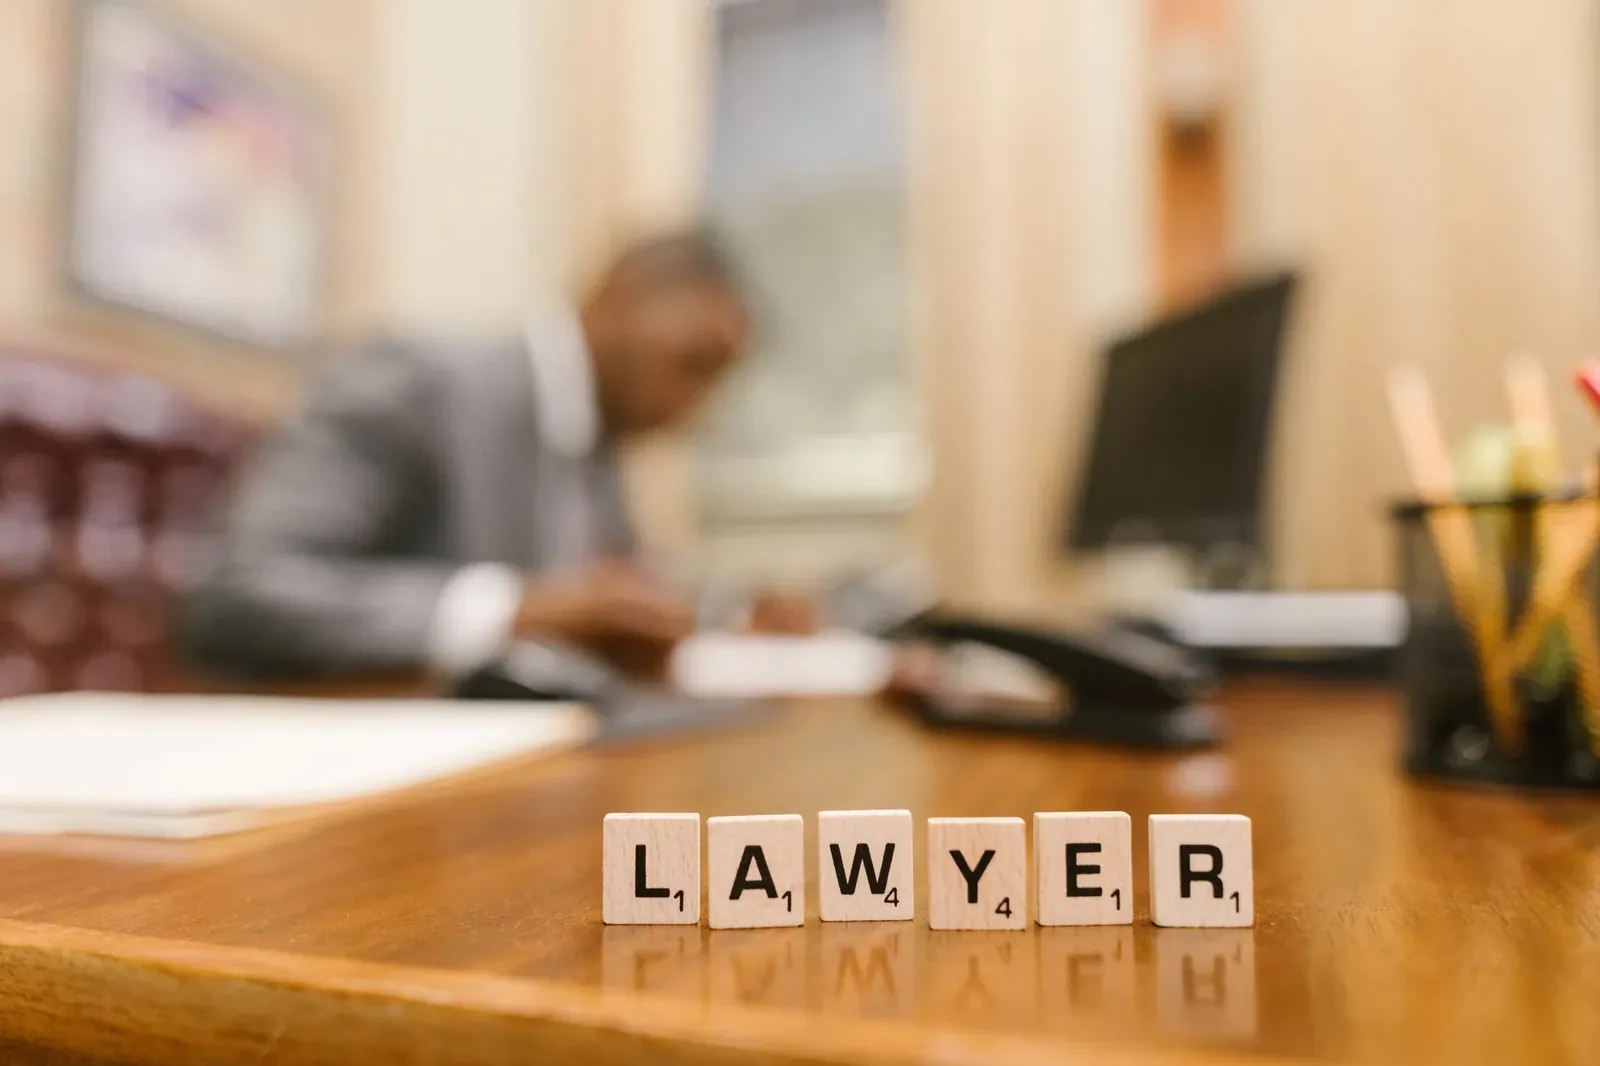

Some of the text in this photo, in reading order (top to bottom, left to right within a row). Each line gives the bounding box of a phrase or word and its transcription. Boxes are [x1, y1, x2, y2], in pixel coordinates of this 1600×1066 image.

[673, 889, 685, 912] 1
[781, 890, 793, 913] 1
[884, 887, 900, 907] 4
[994, 896, 1013, 918] 4
[1110, 888, 1122, 911] 1
[1229, 891, 1241, 913] 1
